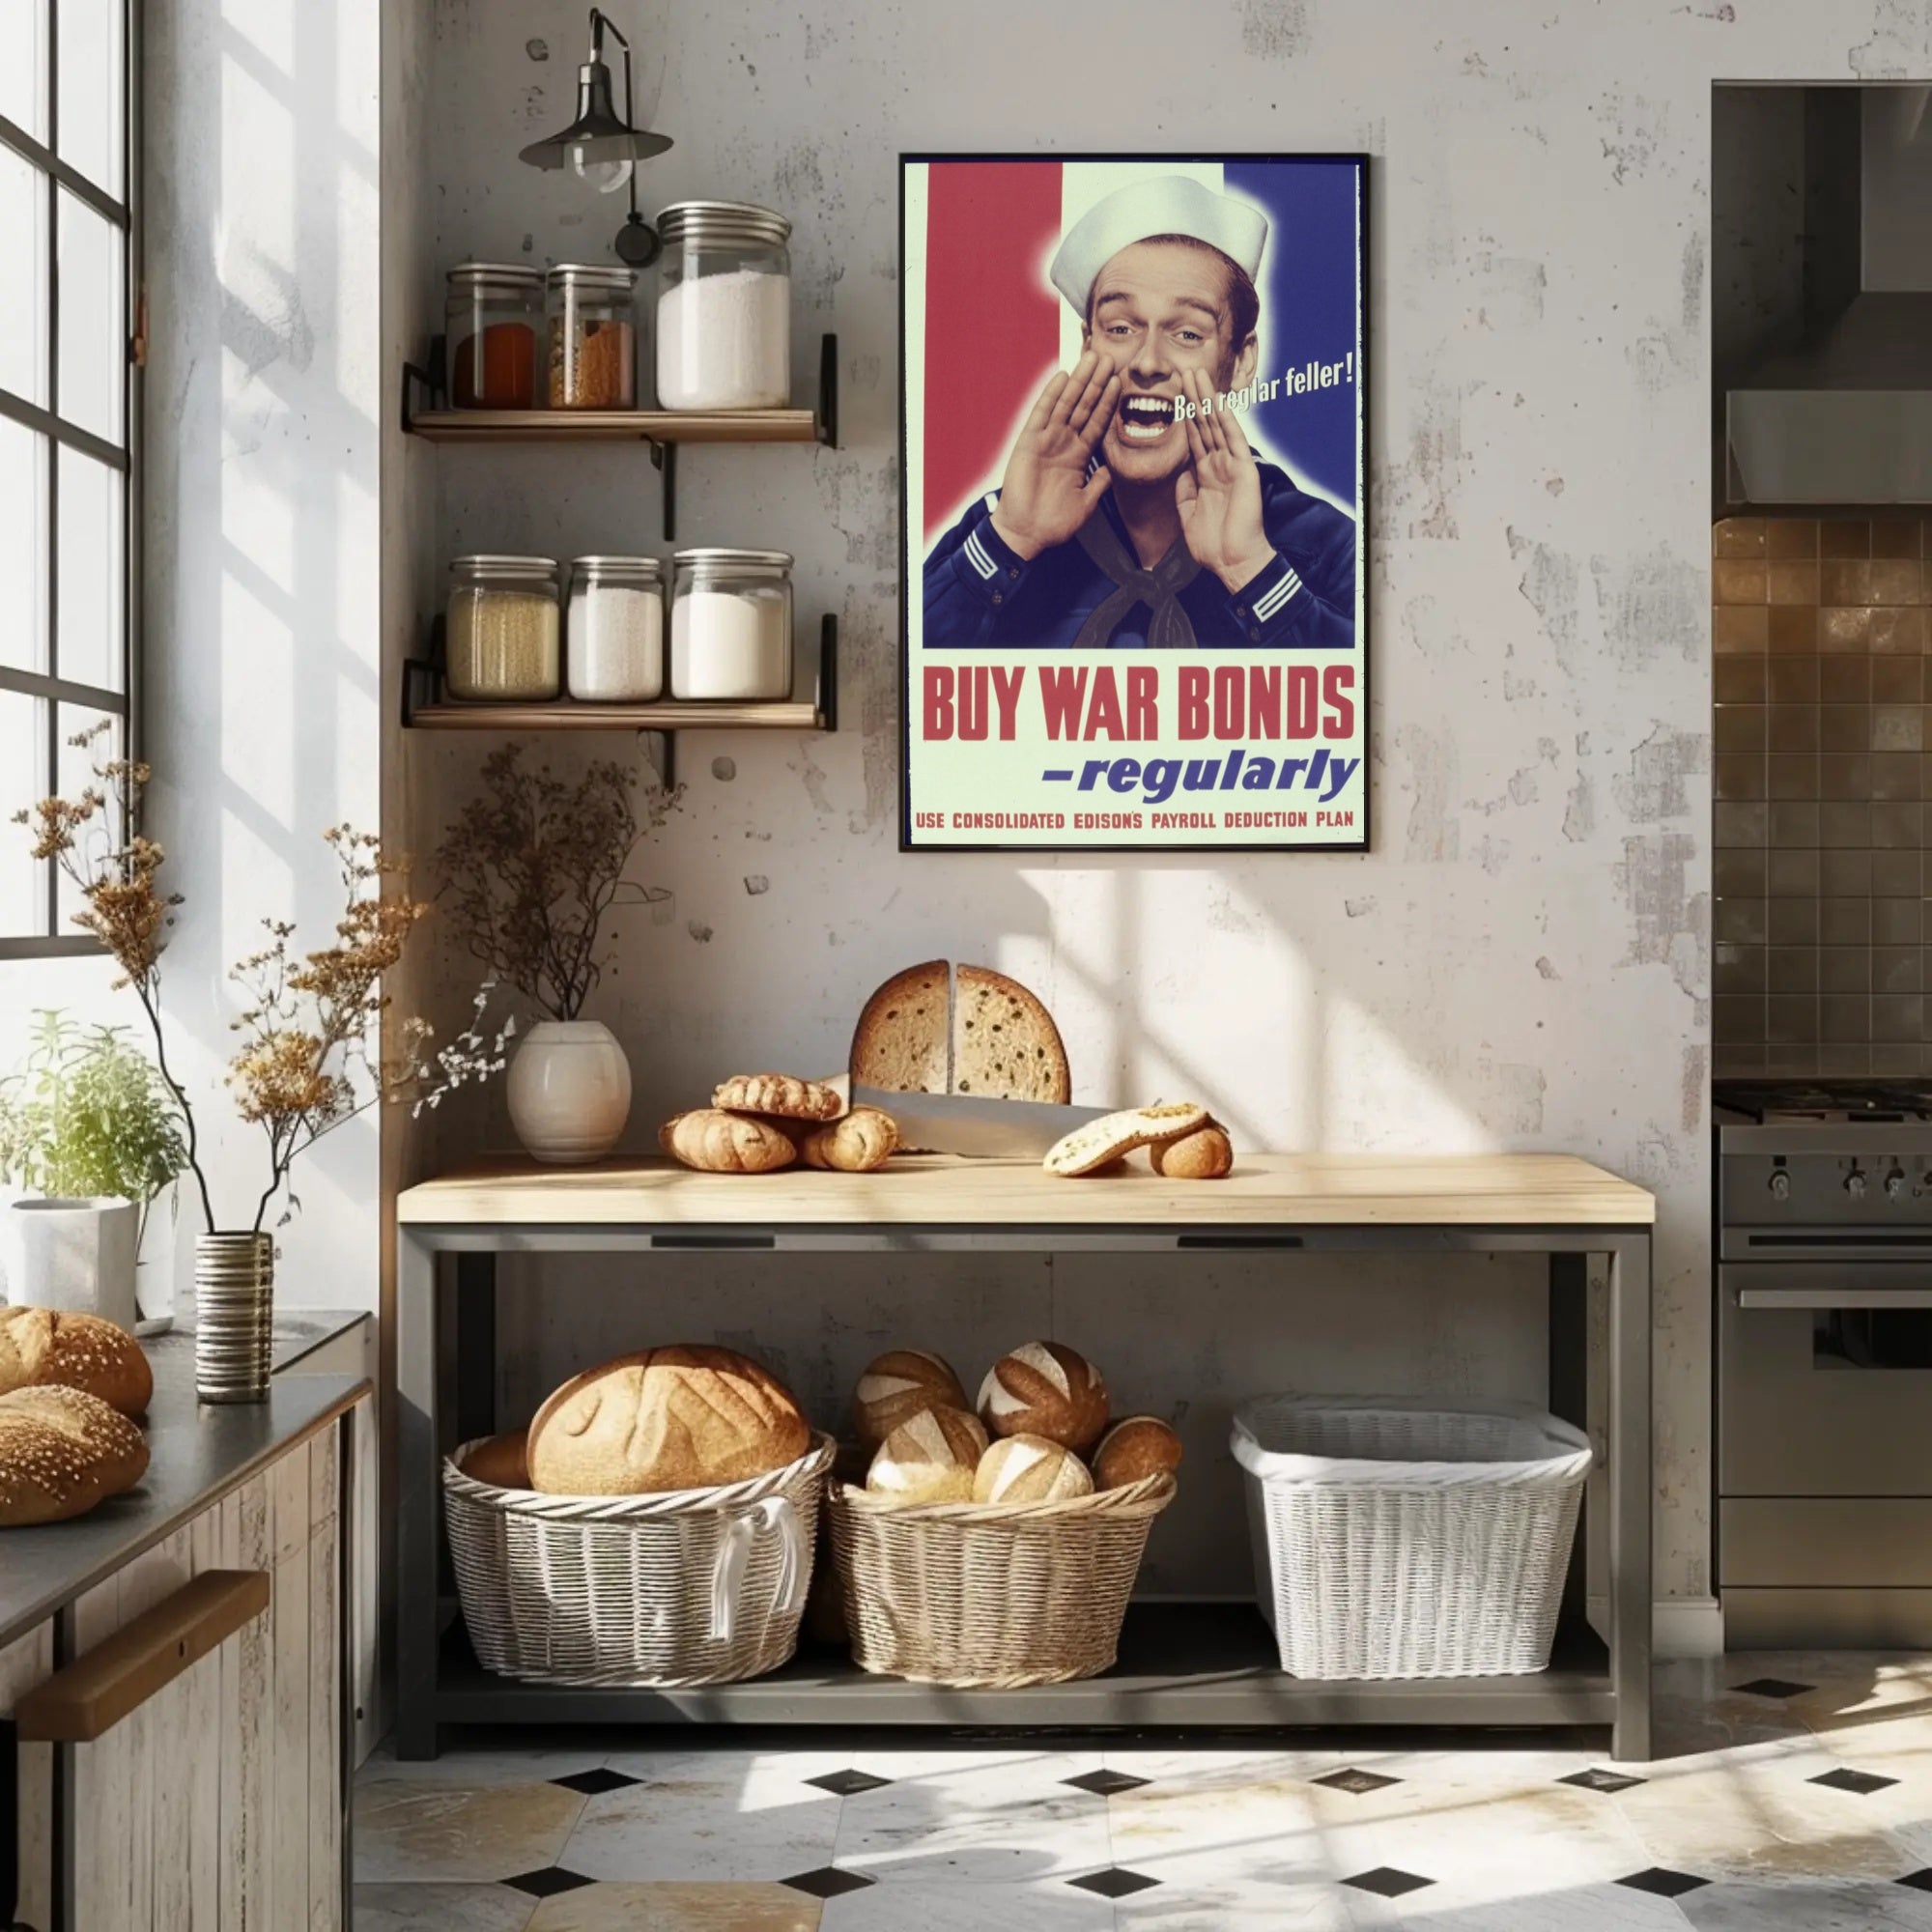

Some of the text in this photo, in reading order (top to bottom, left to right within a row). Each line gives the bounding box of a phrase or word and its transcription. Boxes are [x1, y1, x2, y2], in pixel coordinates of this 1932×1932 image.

[1175, 394, 1196, 422] Be
[1201, 396, 1212, 416] a
[1286, 352, 1352, 396] feller!
[923, 665, 1354, 741] BUY WAR BONDS
[917, 813, 944, 829] USE
[953, 813, 1065, 829] CONSOLIDATED
[1152, 812, 1216, 828] PAYROLL
[1225, 812, 1307, 828] DEDUCTION
[1317, 811, 1353, 827] PLAN
